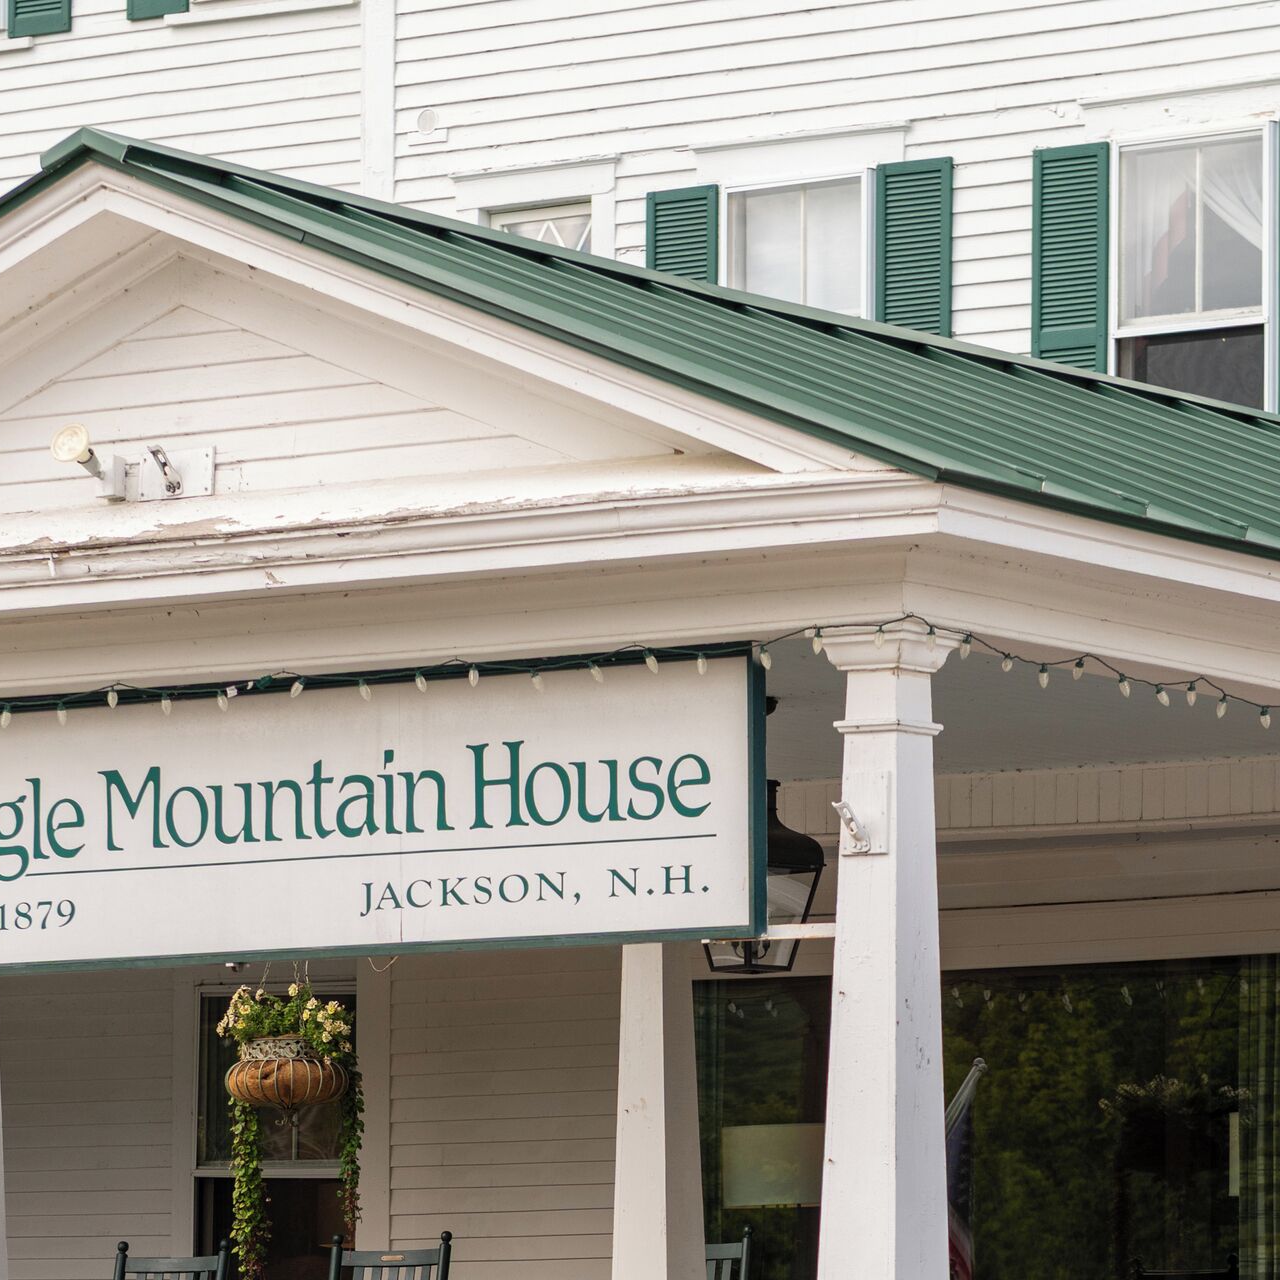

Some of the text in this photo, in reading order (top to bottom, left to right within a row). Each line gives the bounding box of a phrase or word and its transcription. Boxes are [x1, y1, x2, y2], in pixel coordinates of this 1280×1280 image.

[97, 749, 455, 851] Mountain
[465, 740, 712, 830] House
[360, 865, 710, 917] JACKSON, N.H.
